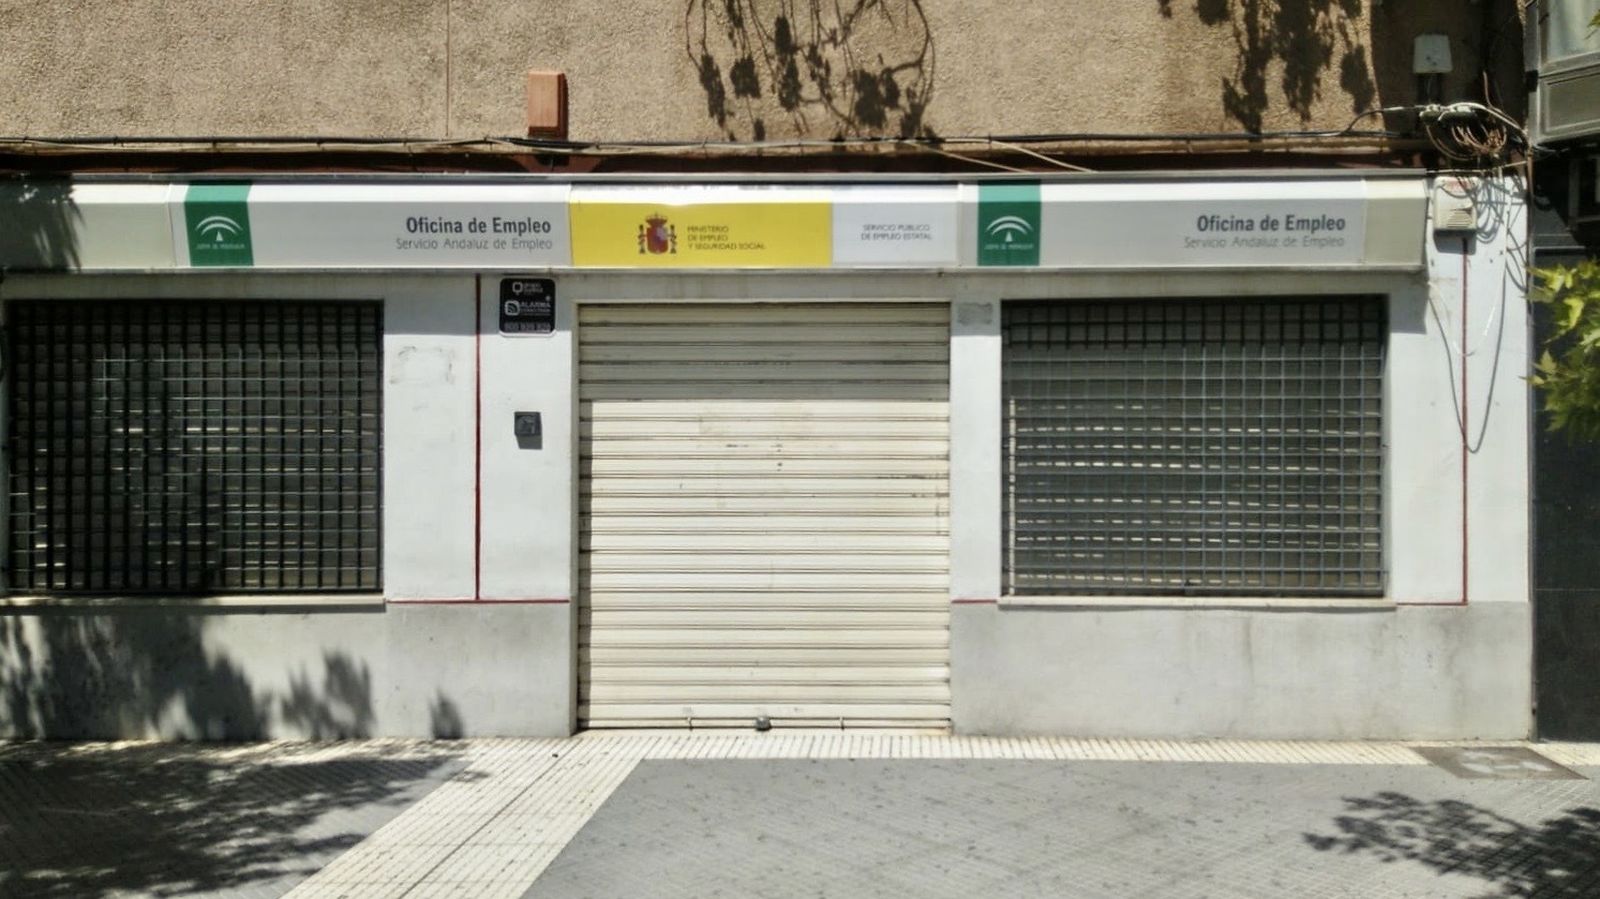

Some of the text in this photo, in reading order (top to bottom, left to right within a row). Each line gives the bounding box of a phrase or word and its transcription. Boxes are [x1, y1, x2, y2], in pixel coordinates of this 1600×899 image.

[406, 216, 552, 237] Oficina de Empleo
[687, 225, 729, 233] MINISTERIO
[1197, 214, 1346, 234] Oficina de Empleo
[396, 238, 553, 253] Servicio Andaluz de Empleo
[687, 234, 729, 242] DE EMPLEO
[1184, 235, 1345, 250] Servicio Andaluz de Empleo
[739, 242, 766, 250] SOCIAL
